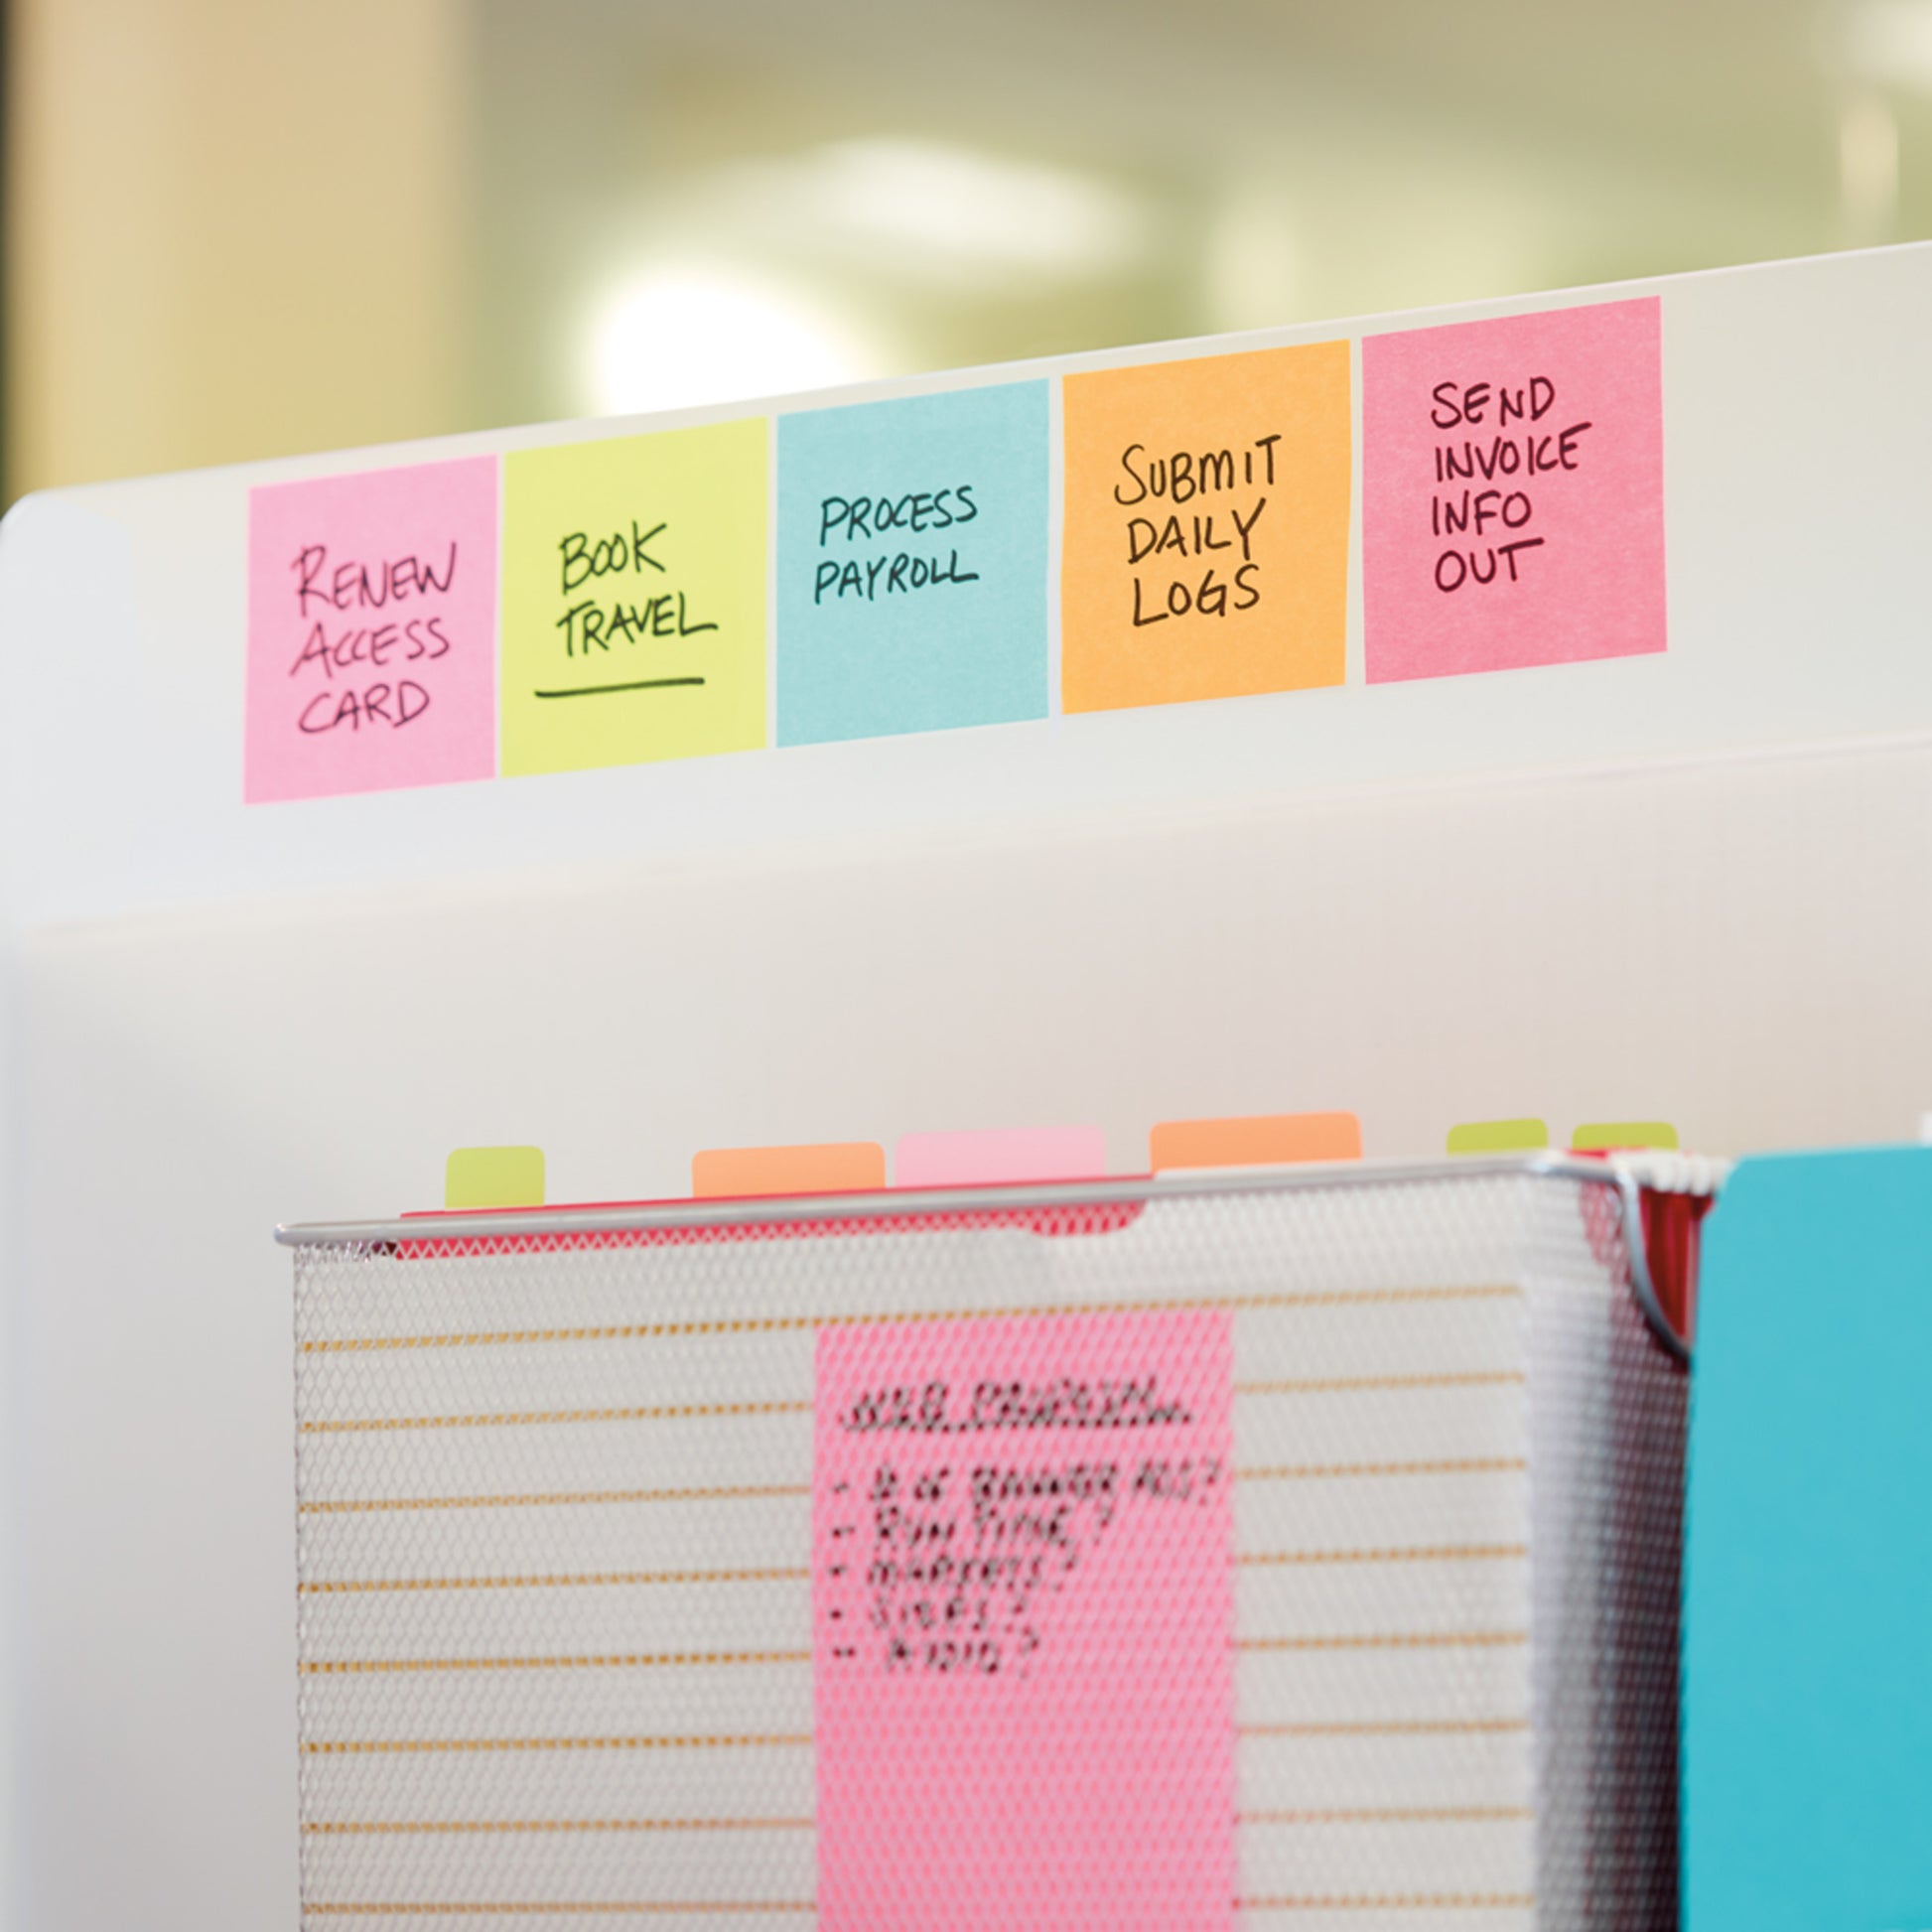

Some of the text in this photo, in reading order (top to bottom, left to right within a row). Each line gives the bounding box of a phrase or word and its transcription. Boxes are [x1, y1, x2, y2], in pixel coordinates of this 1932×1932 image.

[1431, 375, 1556, 430] SEND
[1114, 434, 1282, 504] SUBMIT
[1435, 422, 1592, 483] INVOICE
[820, 484, 978, 546] PROCESS
[1127, 497, 1267, 564] DAILY
[1433, 489, 1532, 536] INFO
[290, 541, 457, 618] RENEW
[559, 520, 668, 596] BOOK
[814, 549, 980, 605] PAYROLL
[1435, 537, 1545, 593] OUT
[556, 592, 719, 657] TRAVEL
[1133, 564, 1260, 626] LOGS
[290, 617, 450, 678] ACCESS
[299, 680, 430, 734] CARD
